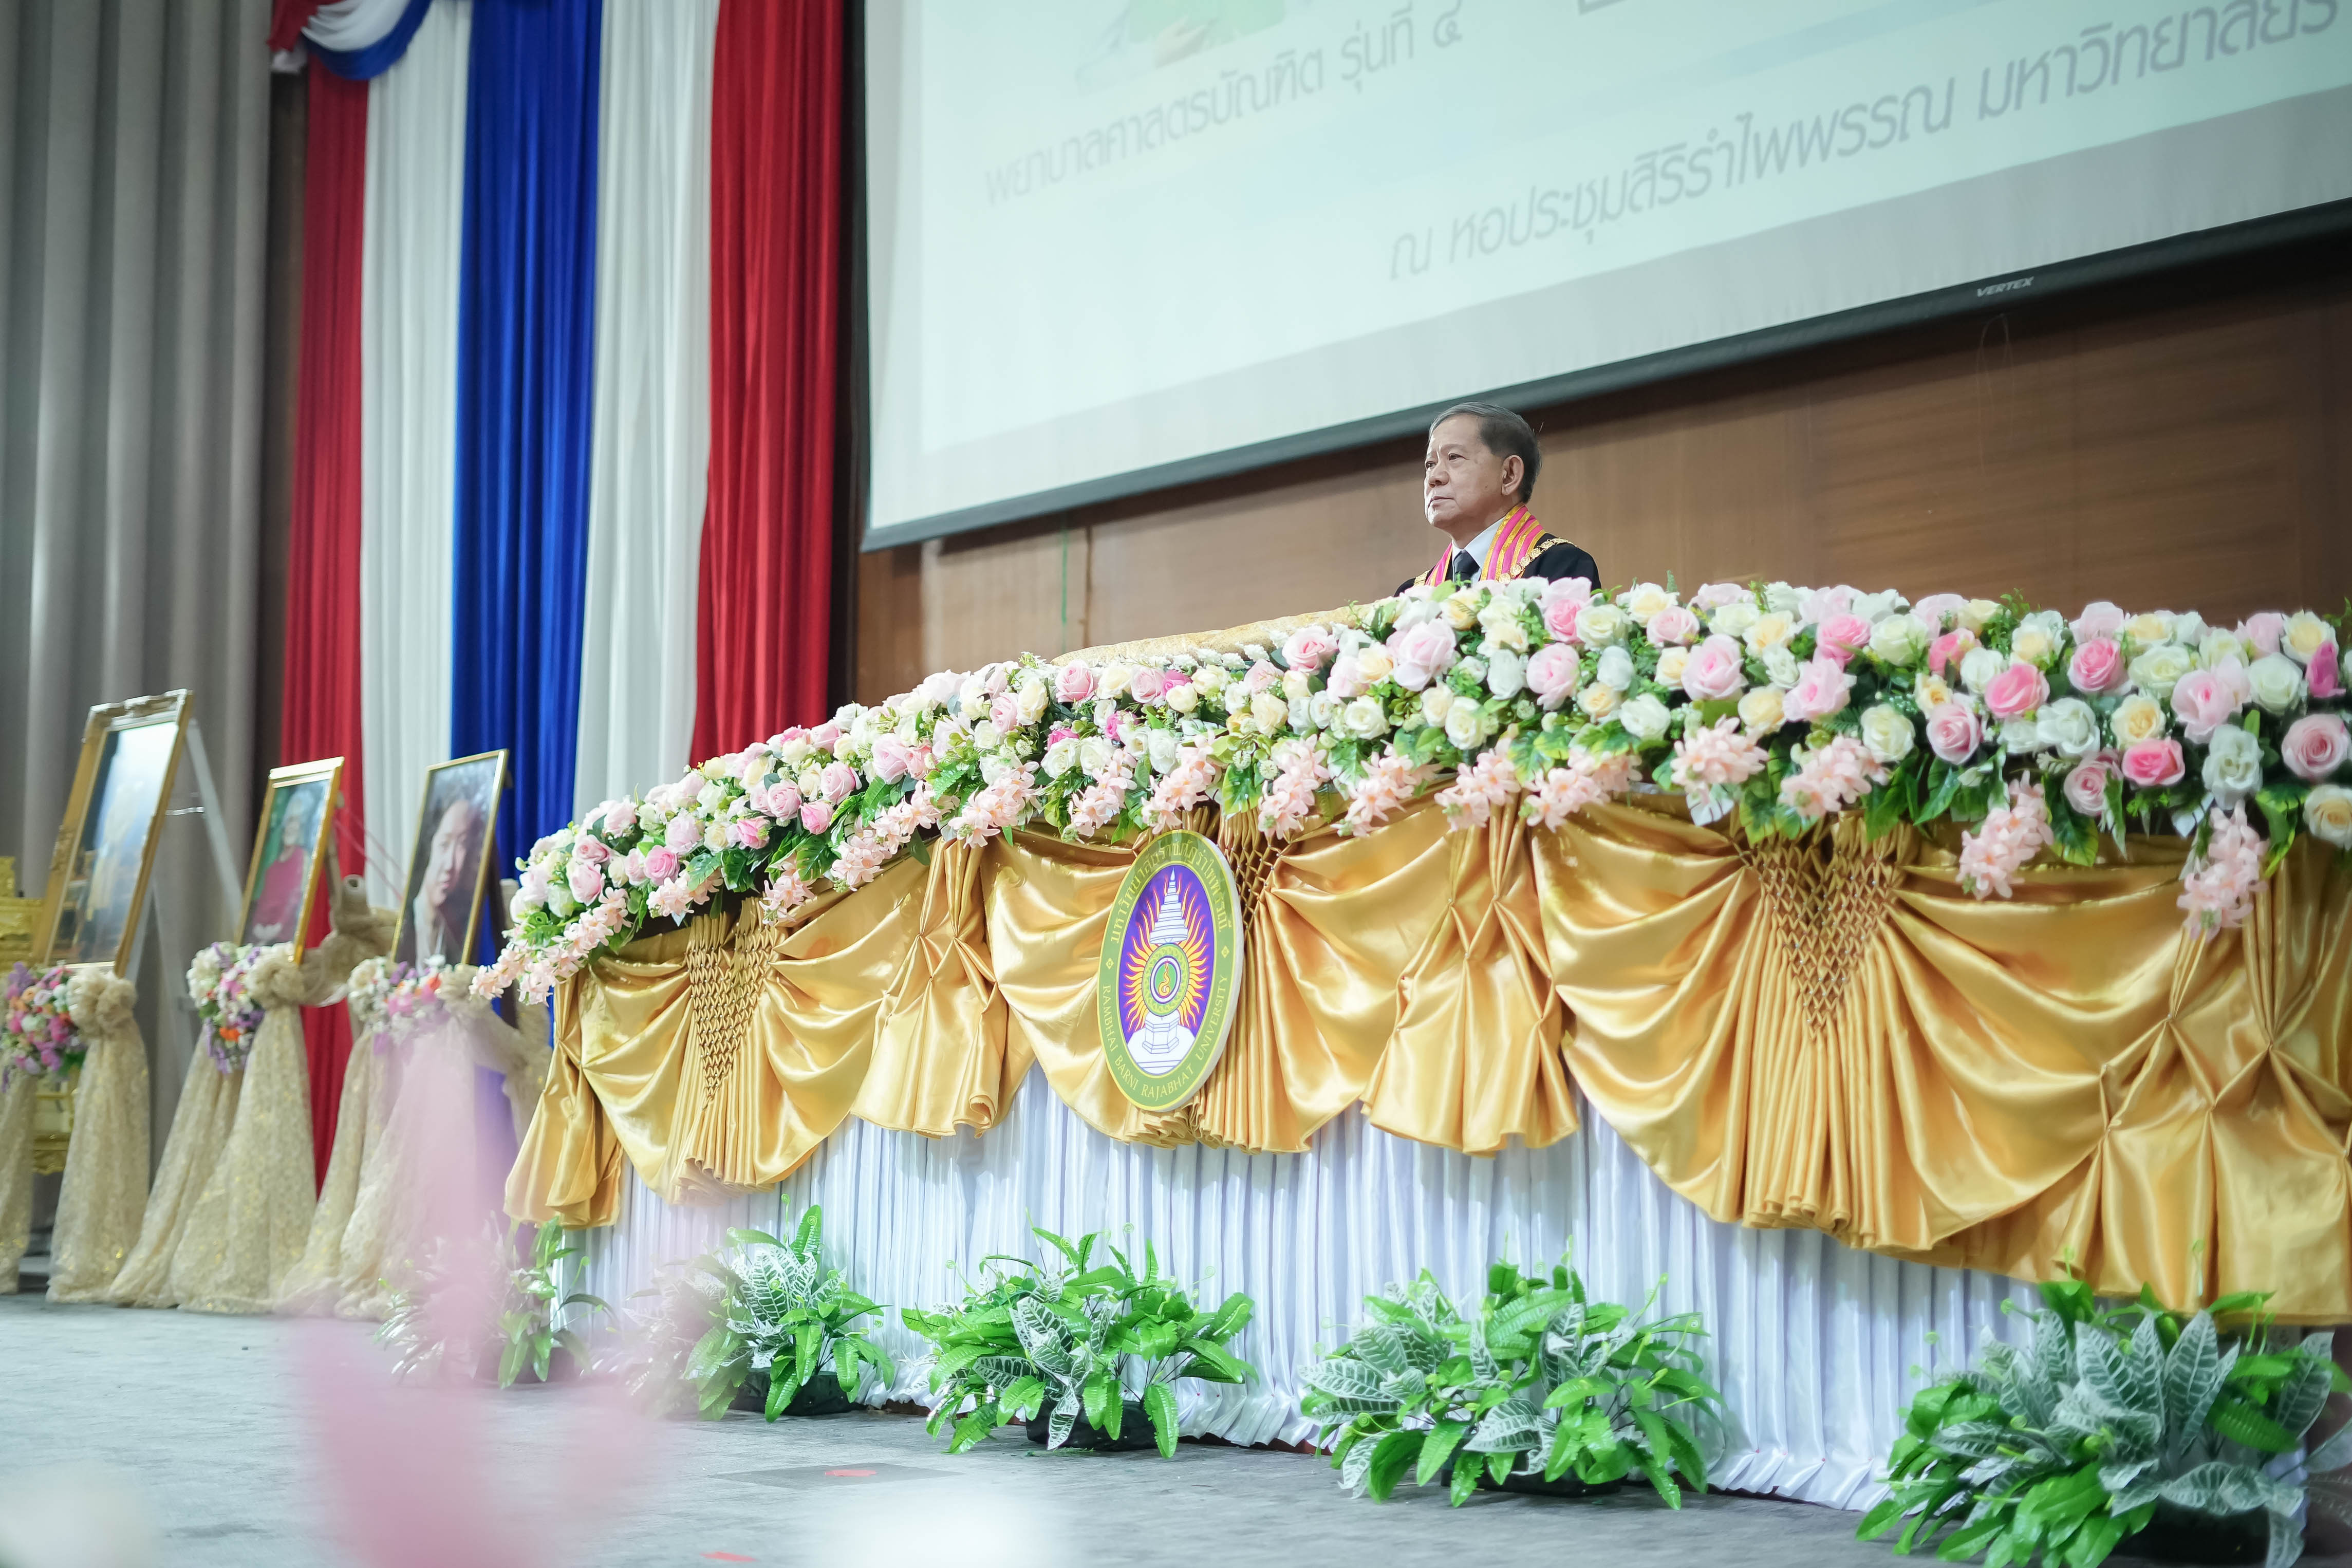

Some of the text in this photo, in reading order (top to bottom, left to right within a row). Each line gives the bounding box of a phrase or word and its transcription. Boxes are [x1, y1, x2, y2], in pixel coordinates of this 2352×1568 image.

[985, 48, 1323, 207] พยาบาลศาสตรบัณฑิต
[1340, 0, 1414, 94] รุ่นที
[1390, 226, 1432, 281] ณ
[1978, 0, 2339, 120] มหาวิทยาลยร
[1976, 276, 2034, 297] VERTEX
[1103, 975, 1228, 1102] RAMBHAI BARNI RAJABHAT UNIVERSITY
